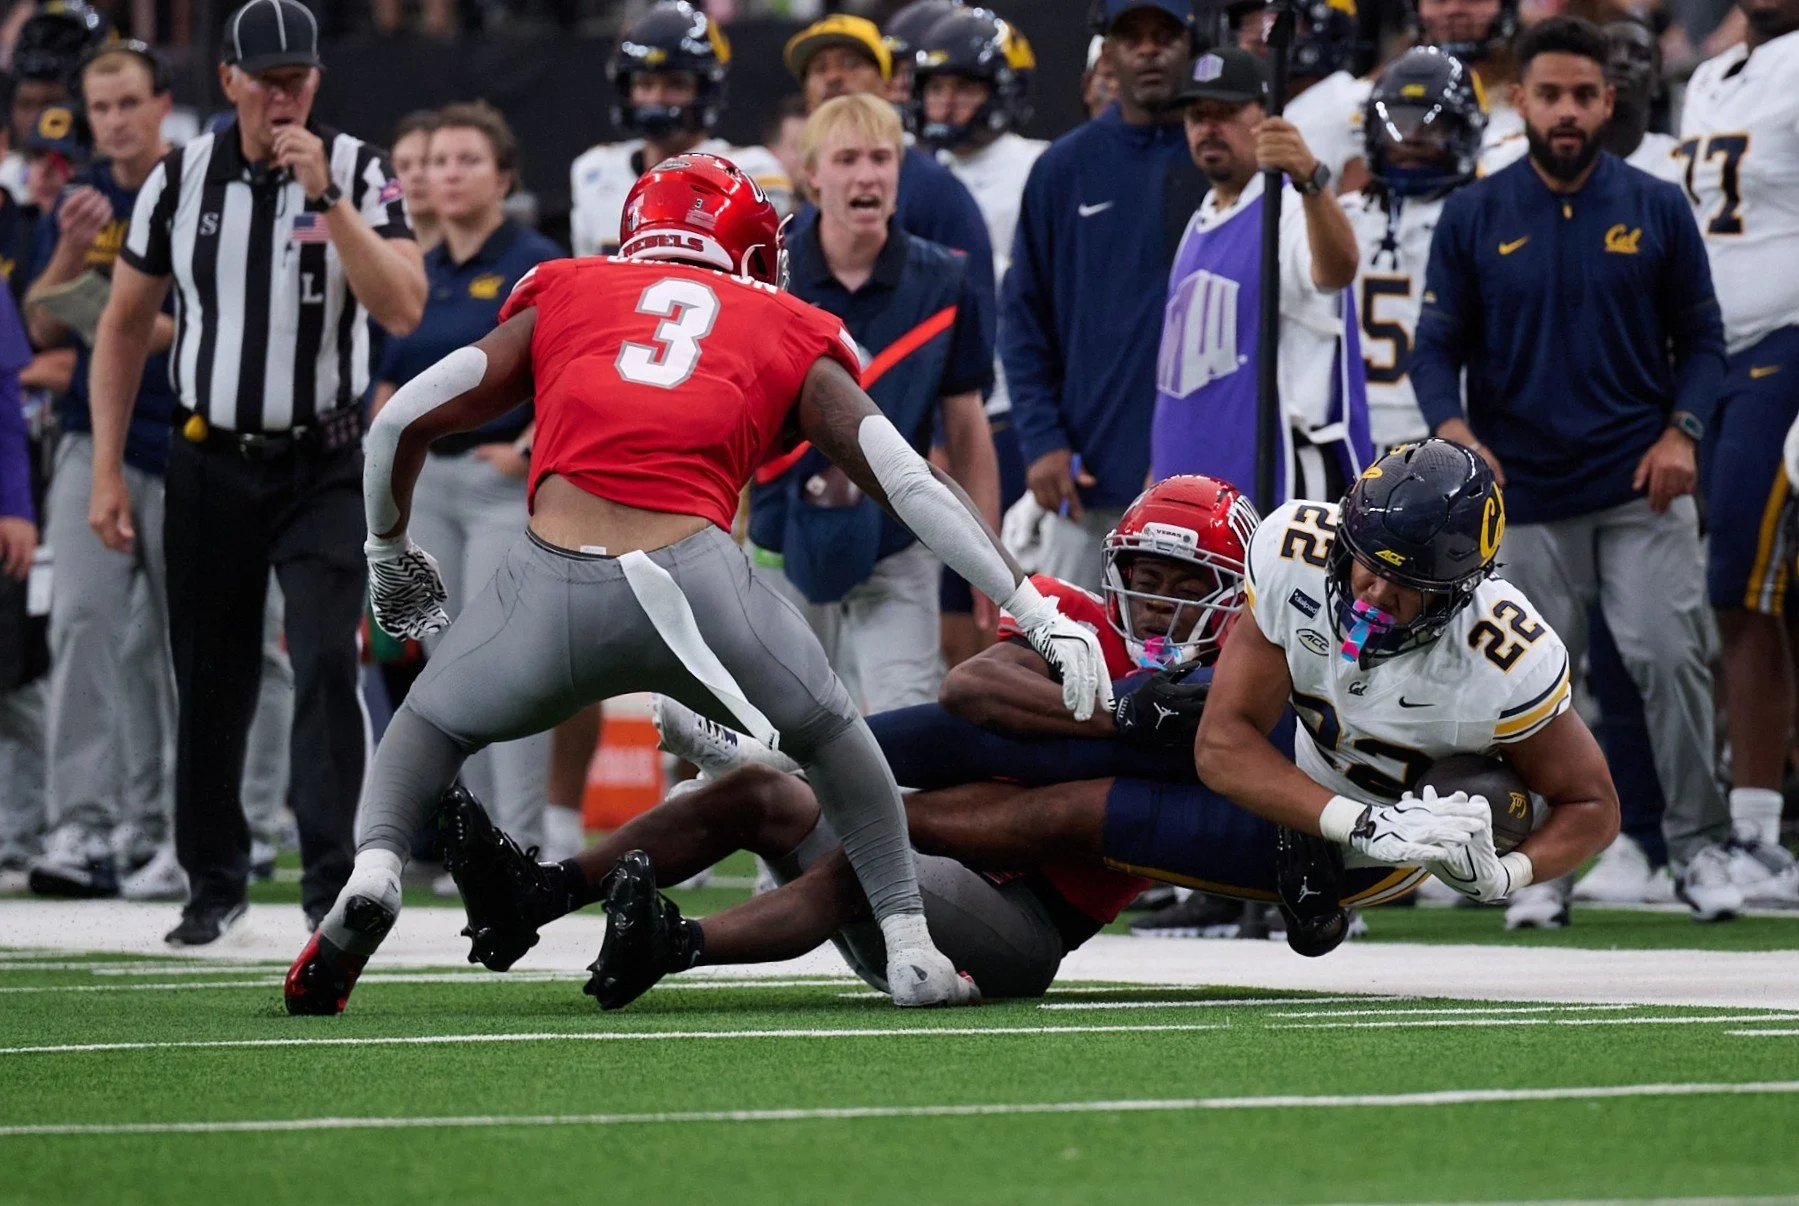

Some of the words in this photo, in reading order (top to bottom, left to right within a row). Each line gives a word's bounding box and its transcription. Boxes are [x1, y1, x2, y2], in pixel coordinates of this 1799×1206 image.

[200, 212, 219, 236] S
[1604, 223, 1642, 254] Cal
[622, 234, 704, 257] REBELS
[302, 273, 323, 303] L
[614, 276, 721, 391] 3
[1361, 274, 1412, 387] 5
[1278, 503, 1336, 570] 22
[1374, 549, 1406, 567] ACC
[1301, 634, 1330, 652] ACC
[1467, 599, 1547, 675] 22
[1347, 681, 1368, 697] Cal
